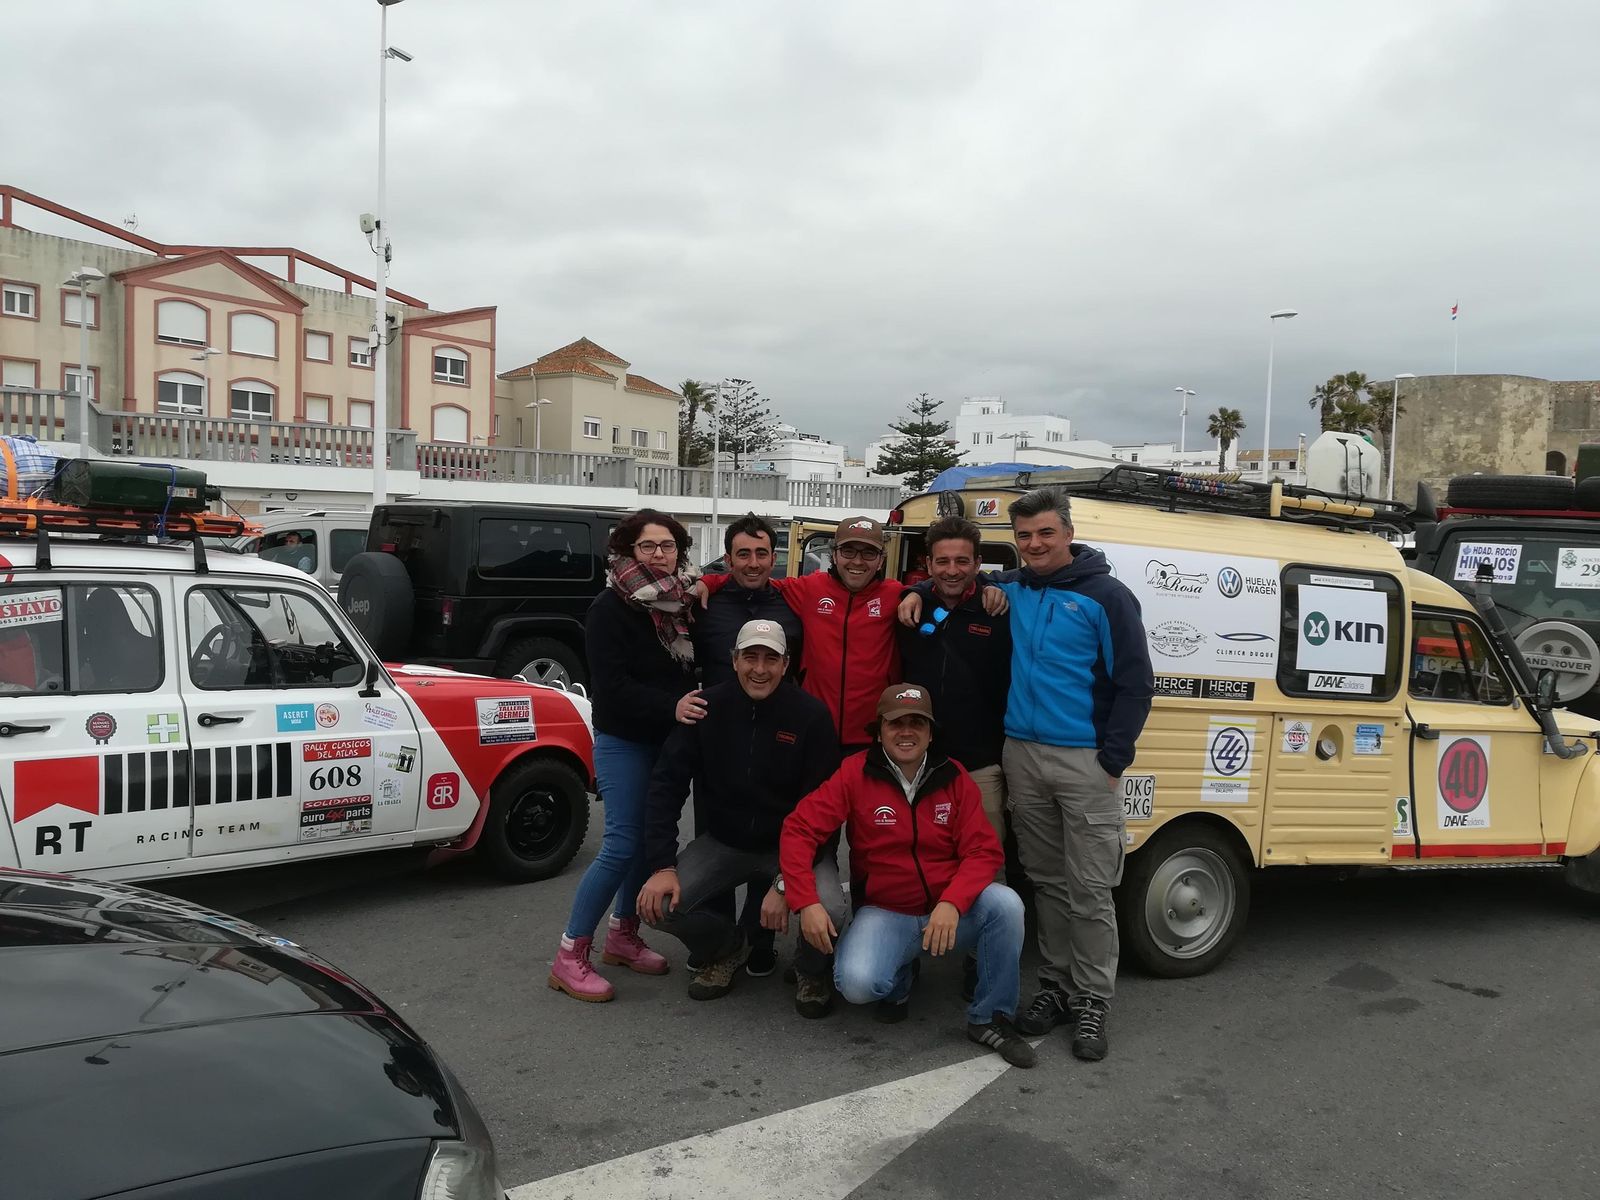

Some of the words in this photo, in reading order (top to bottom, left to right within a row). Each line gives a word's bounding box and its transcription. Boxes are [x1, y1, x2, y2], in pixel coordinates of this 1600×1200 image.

[1161, 576, 1203, 594] Rosa
[1245, 577, 1277, 587] HUELVA
[1247, 586, 1276, 595] WAGEN
[348, 597, 370, 615] Jeep
[1250, 649, 1273, 657] DUQUE
[1526, 657, 1548, 665] AND
[1552, 660, 1592, 670] ROVER
[1154, 678, 1194, 689] HERCE
[1209, 680, 1248, 692] HERCE
[1314, 675, 1346, 688] DYANE
[283, 711, 308, 719] ASERET
[304, 743, 327, 752] RALLY
[332, 740, 371, 750] CLASICOS
[317, 751, 332, 760] DEL
[336, 748, 358, 758] ATLAS
[310, 765, 361, 790] 608
[1446, 751, 1479, 798] 40
[305, 796, 370, 808] SOLIDARIO
[302, 813, 325, 823] euro
[326, 809, 346, 821] 4x4
[346, 807, 370, 820] parts
[1444, 815, 1468, 827] DYANE
[35, 821, 92, 856] RT
[137, 826, 204, 844] RACING
[218, 821, 261, 834] TEAM
